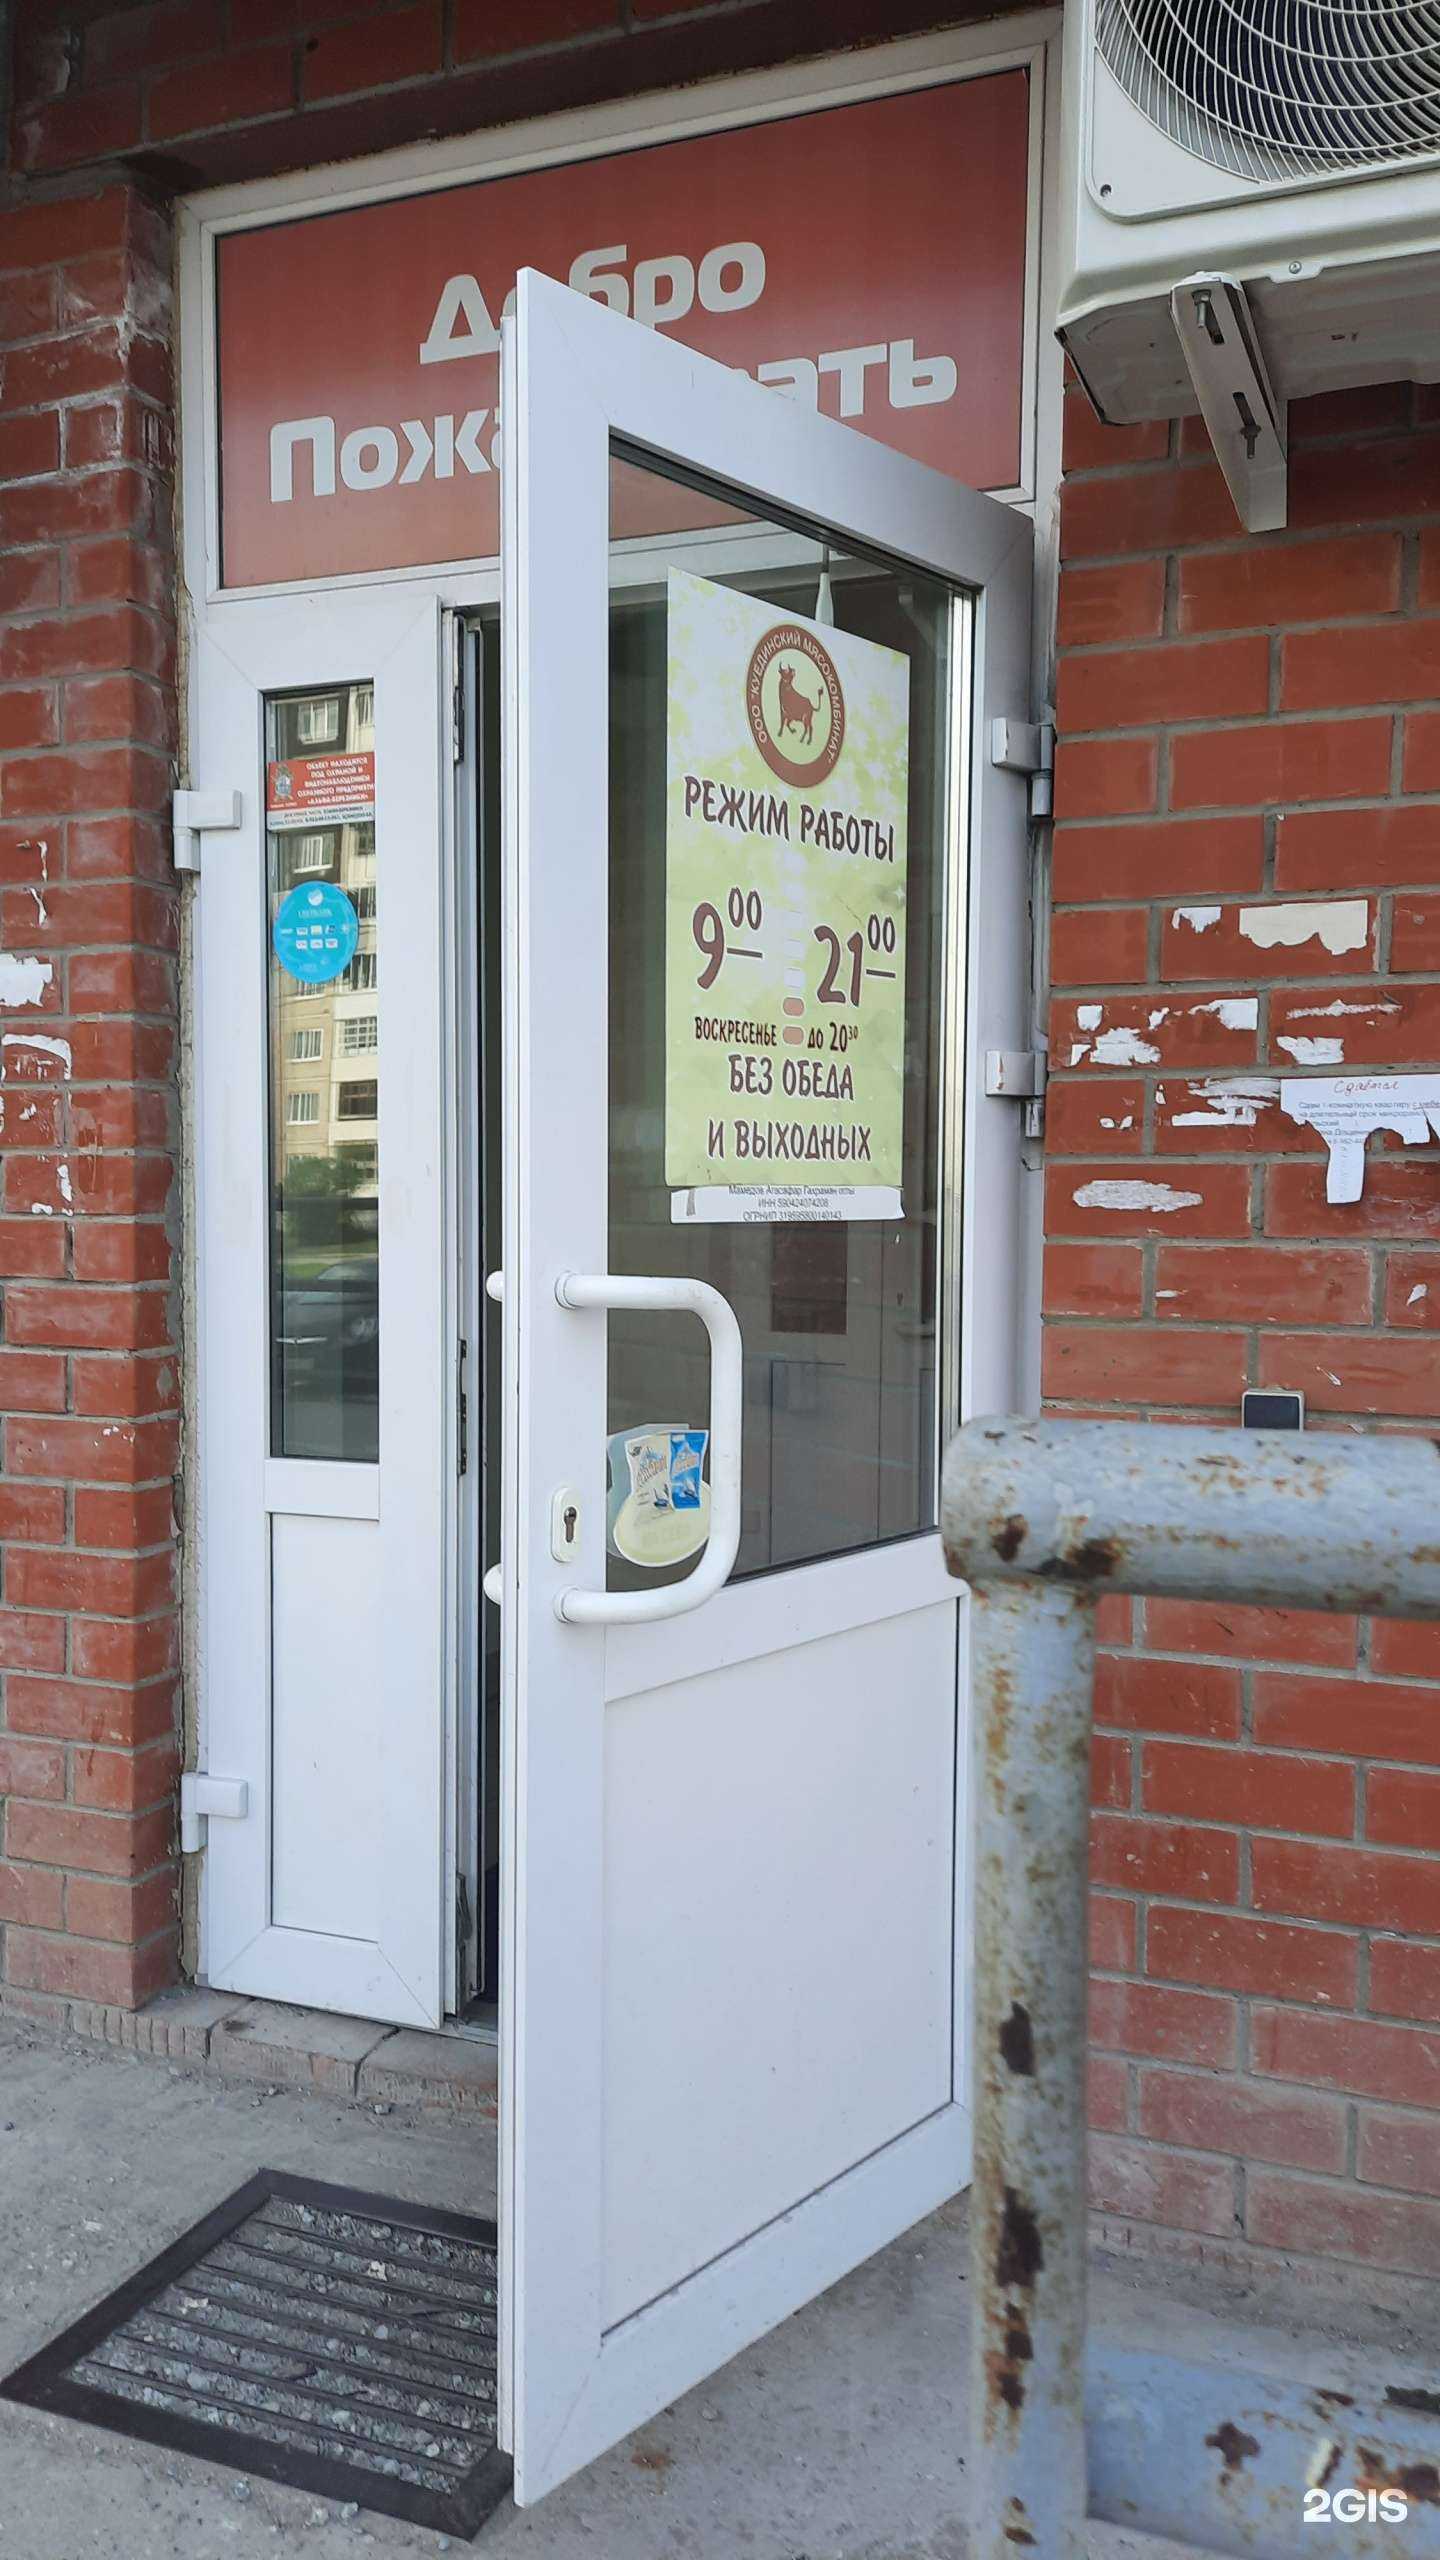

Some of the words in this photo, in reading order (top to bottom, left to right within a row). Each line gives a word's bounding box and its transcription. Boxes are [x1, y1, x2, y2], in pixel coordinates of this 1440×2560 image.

[684, 775, 790, 842] РЕЖИМ
[800, 804, 894, 863] РАБОТЫ
[695, 1016, 778, 1047] ВОСКРЕСЕНЬЕ
[728, 1054, 773, 1095] БЕЗ
[782, 1058, 855, 1101] ОБЕДА
[708, 1119, 725, 1159] И
[735, 1119, 872, 1161] ВЫХОДНЫХ
